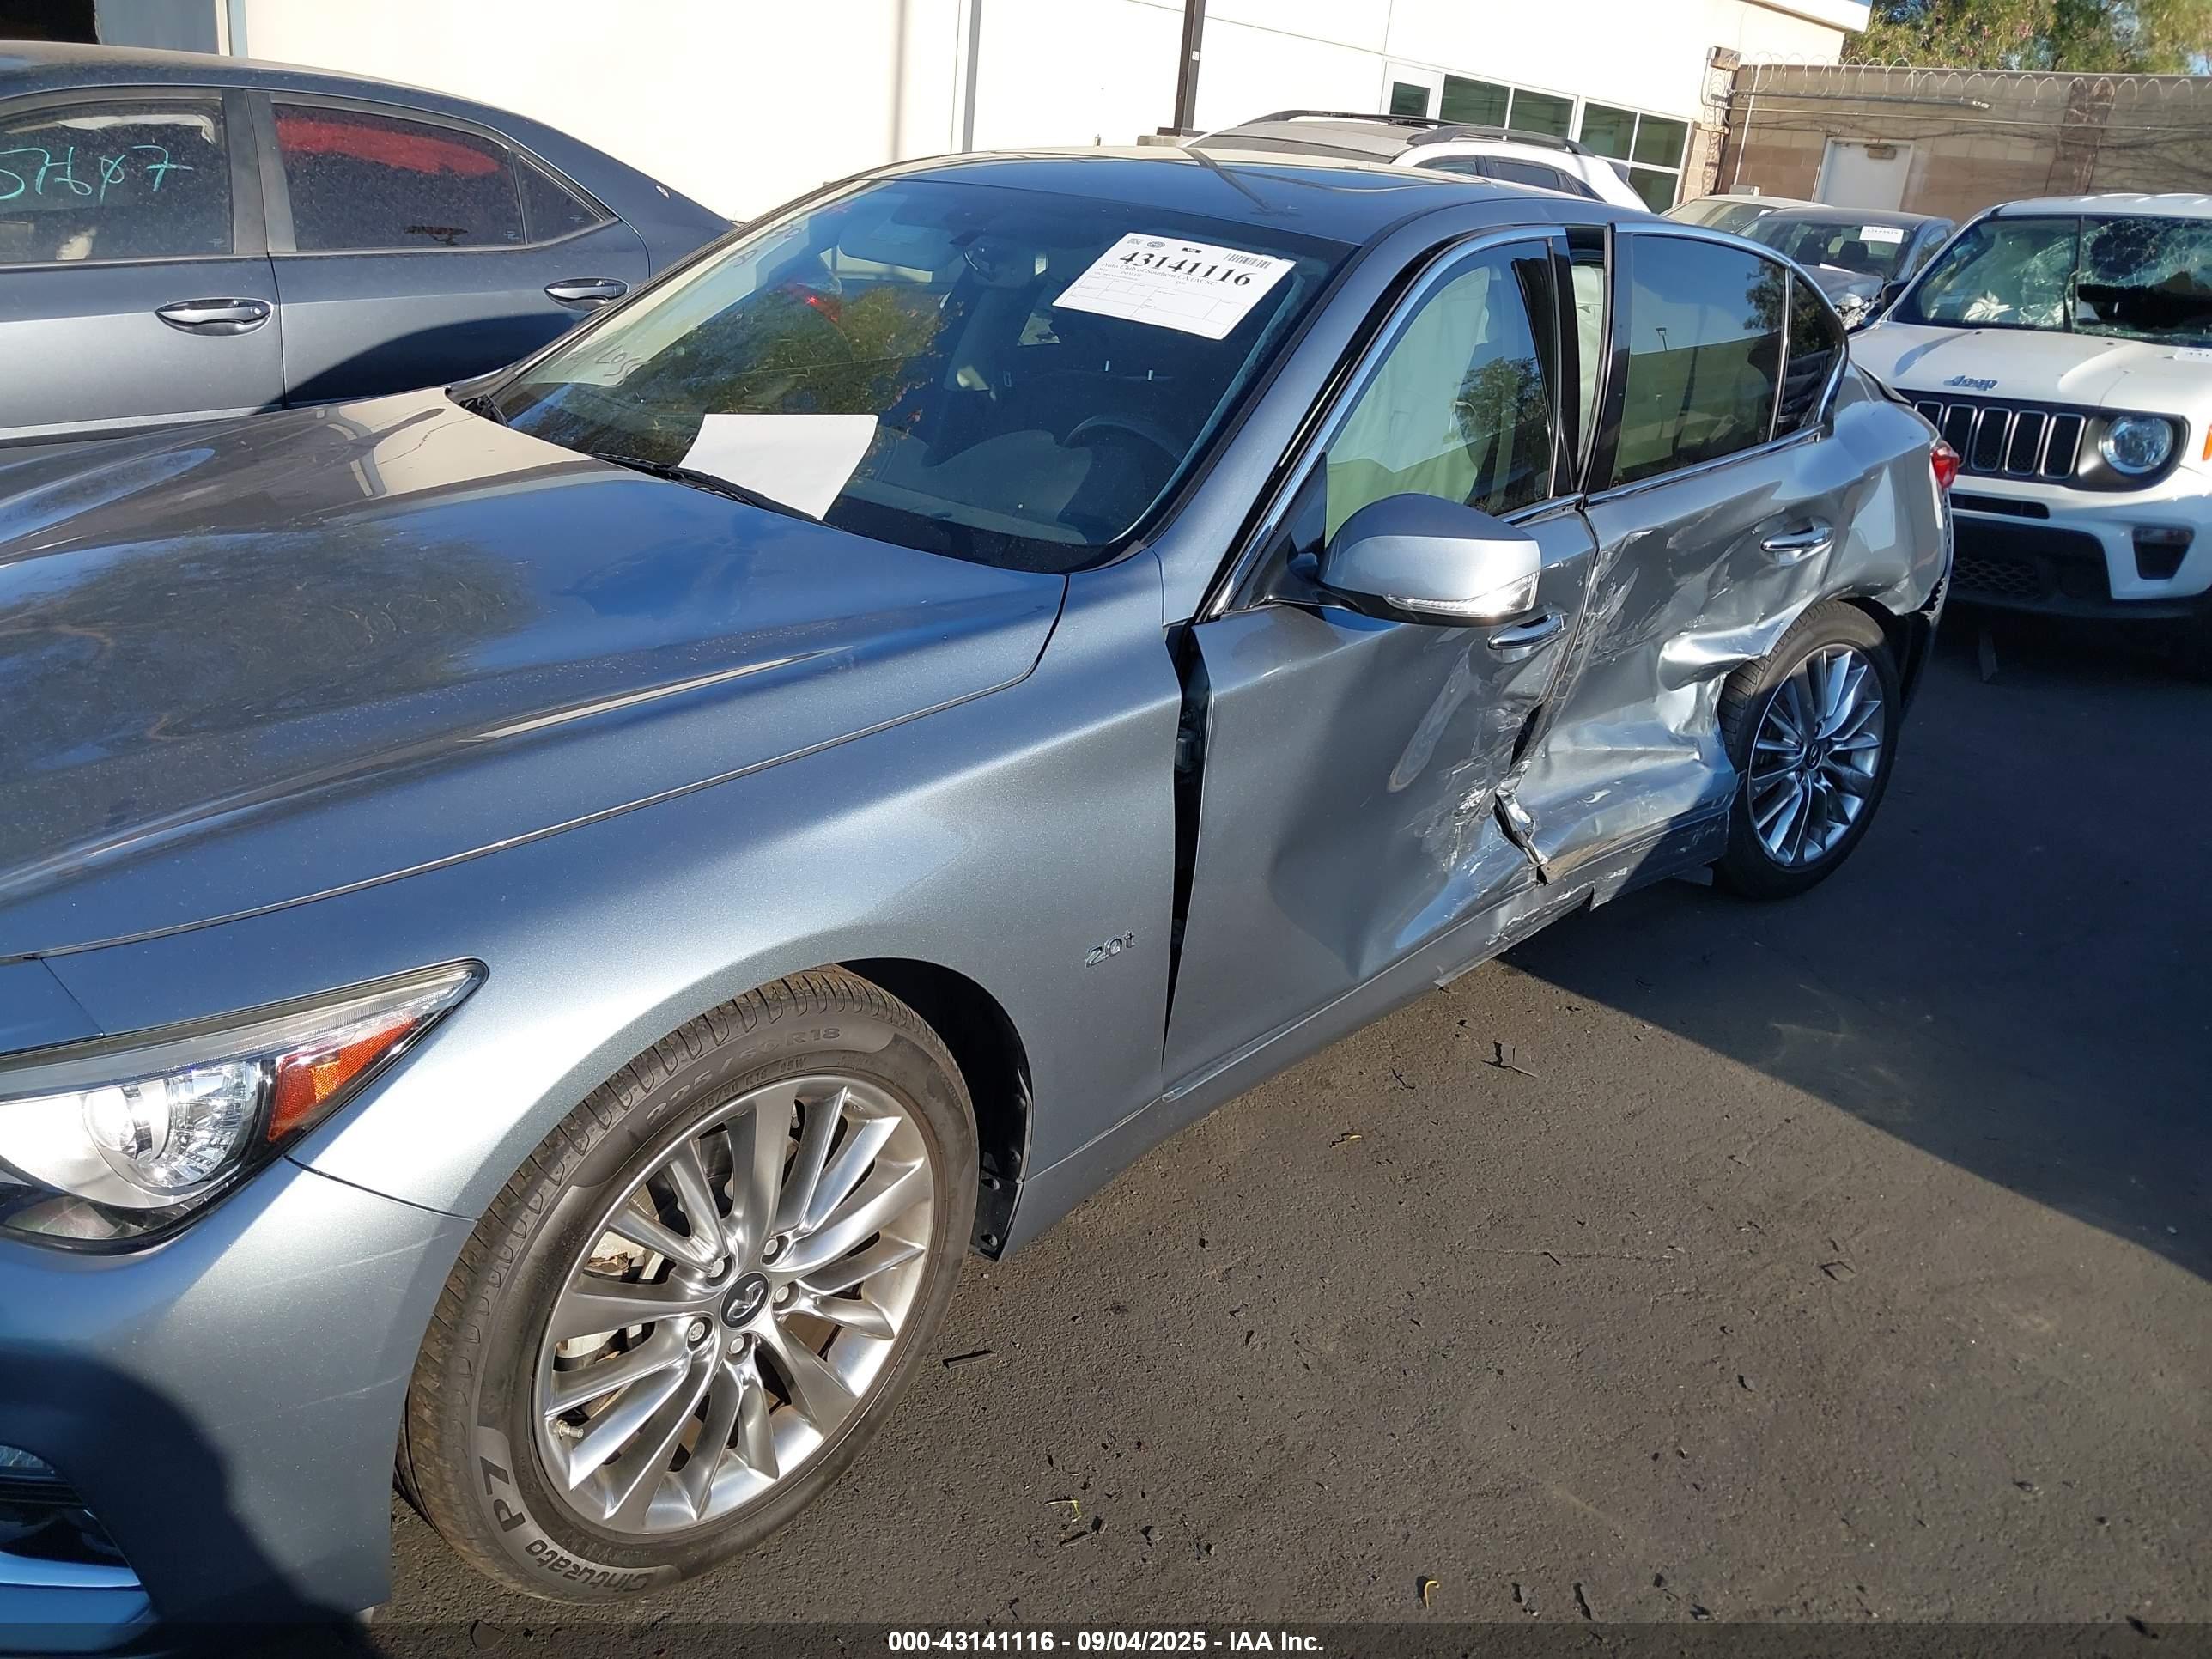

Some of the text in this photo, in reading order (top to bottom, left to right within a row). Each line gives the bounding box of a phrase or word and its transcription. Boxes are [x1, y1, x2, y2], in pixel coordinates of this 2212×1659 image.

[1119, 251, 1257, 286] 43141116
[1950, 374, 1998, 391] Jeep
[785, 1027, 841, 1046] R18
[479, 1455, 526, 1533] P7
